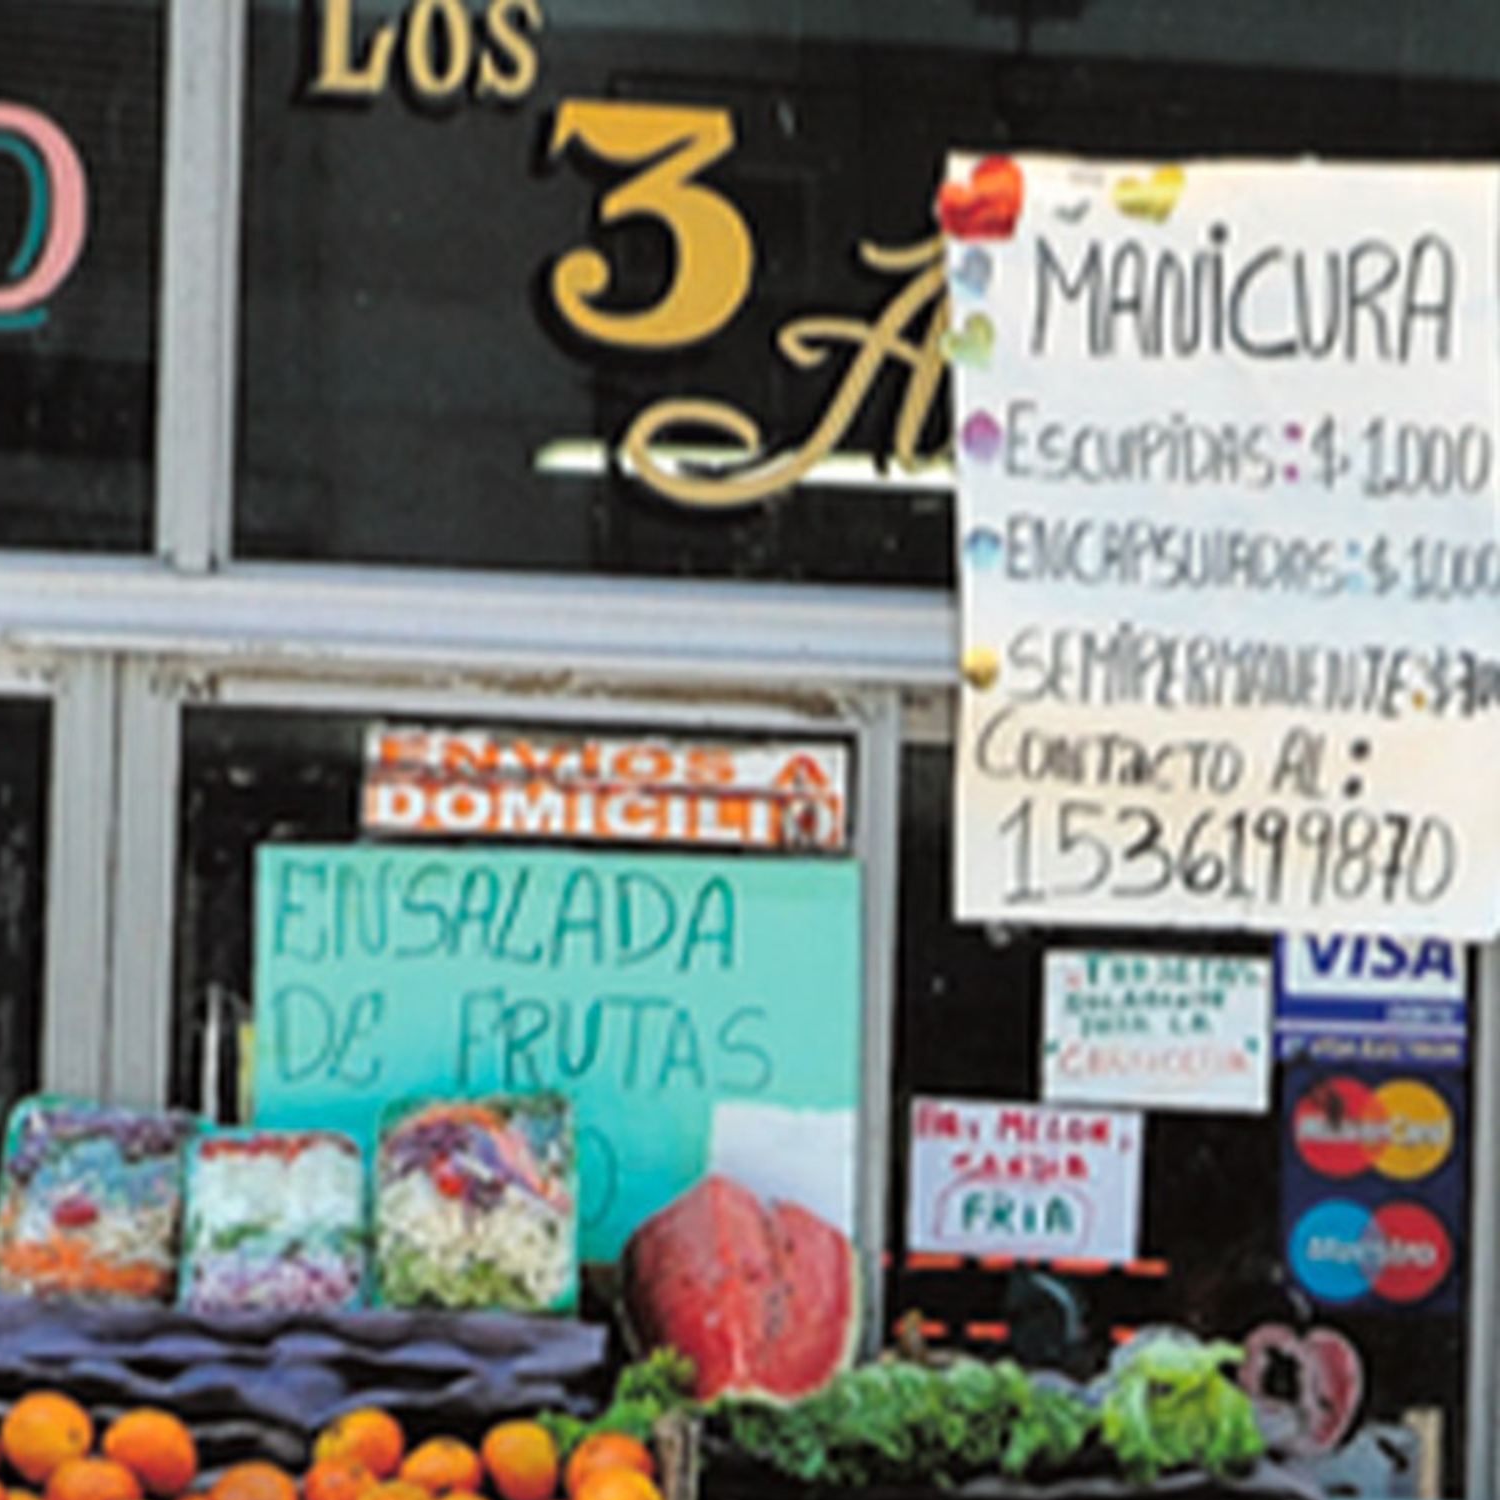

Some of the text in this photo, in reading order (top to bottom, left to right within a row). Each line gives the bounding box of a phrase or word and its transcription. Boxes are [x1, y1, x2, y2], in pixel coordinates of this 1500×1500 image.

[308, 0, 543, 98] LOS
[552, 100, 753, 348] 3
[376, 782, 842, 850] DOMICILIO
[273, 860, 737, 972] ENSALADA
[1302, 928, 1458, 982] VISA
[272, 985, 777, 1097] DE FRUTAS
